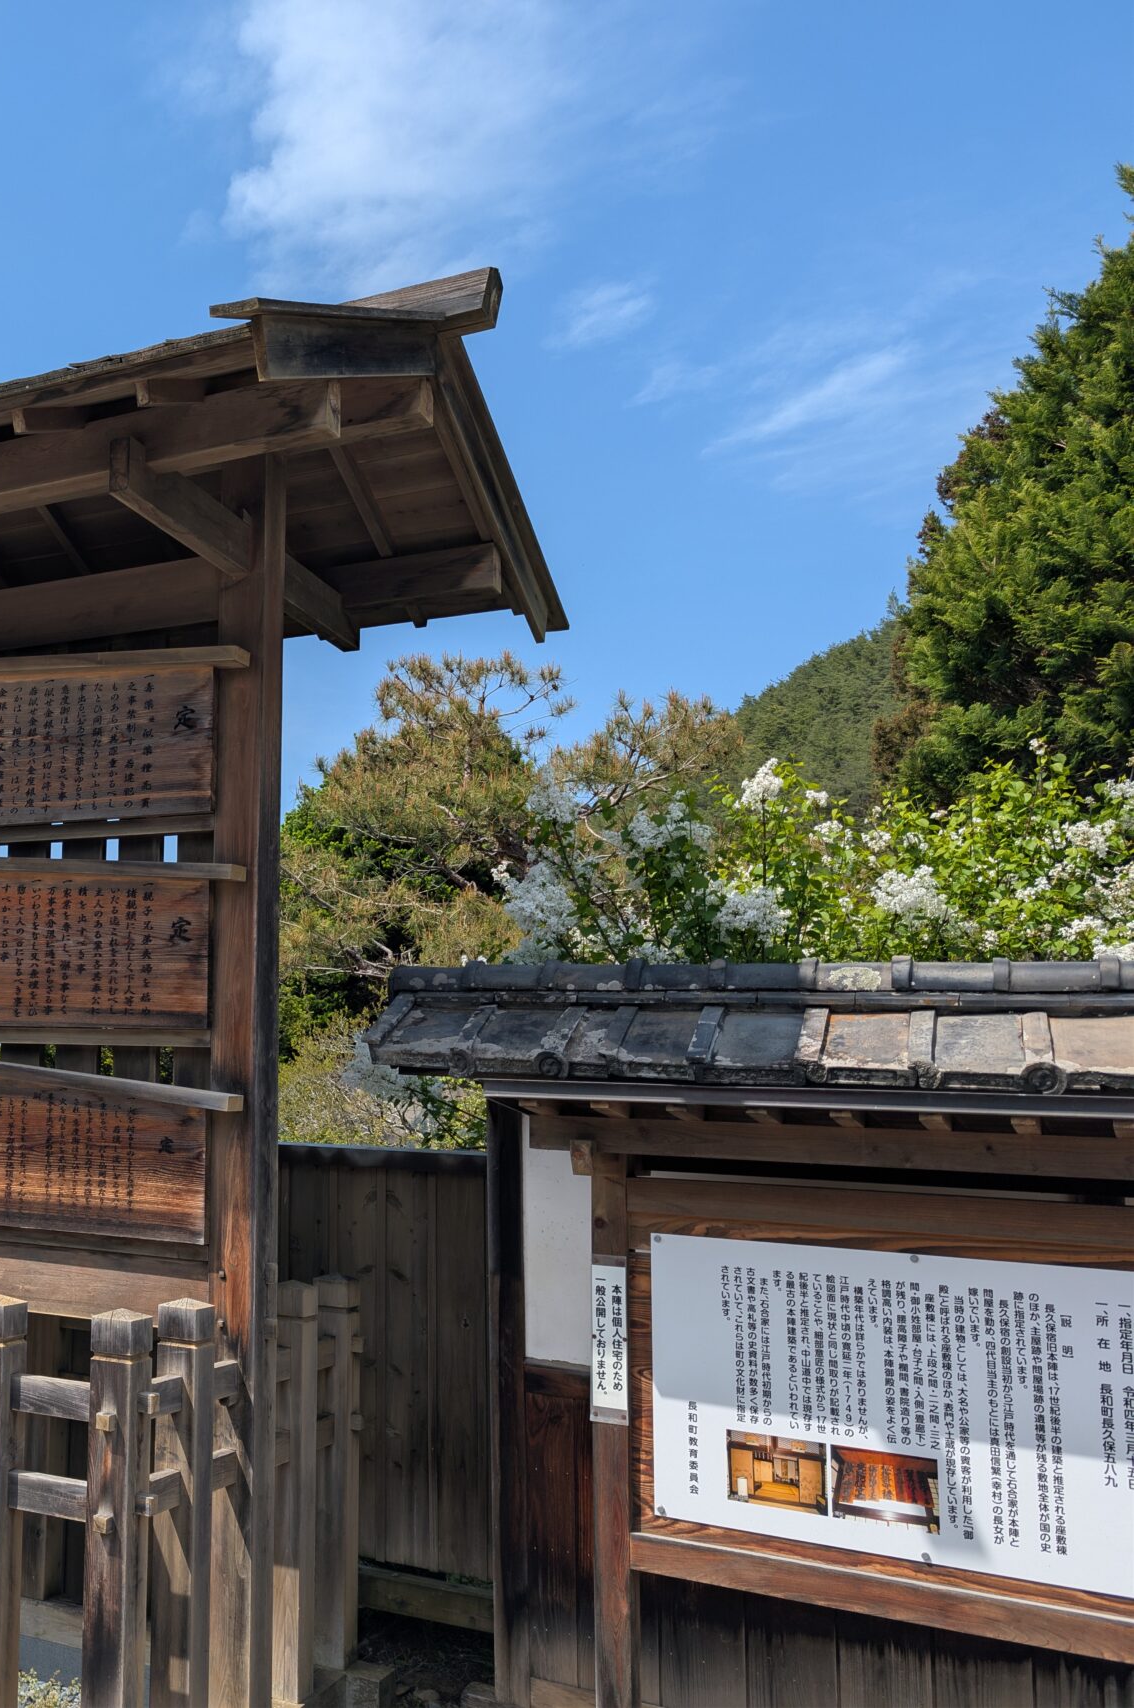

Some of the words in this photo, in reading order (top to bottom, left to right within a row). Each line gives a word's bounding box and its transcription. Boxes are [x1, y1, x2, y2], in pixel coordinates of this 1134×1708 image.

[173, 705, 196, 730] 定
[169, 916, 194, 942] 定
[158, 1136, 175, 1155] 定
[595, 1277, 607, 1395] 一般公開しておりません。
[611, 1284, 623, 1392] 本陣は個人住宅のため
[720, 1265, 731, 1321] されています。
[733, 1266, 746, 1423] されていて、これらは町の文化財に指定
[746, 1267, 759, 1425] 古文書や高札等の史資料が数多く保存
[759, 1277, 773, 1426] また、石合家には江戸時代初期からの
[772, 1269, 782, 1291] ます。
[785, 1271, 799, 1430] る最古の本陣建築であるといわれてい
[798, 1272, 812, 1432] 紀後半と推定され、中山道中では現存す
[826, 1274, 841, 1436] 絵図面に現状と同じ間取りが記載され
[867, 1278, 879, 1329] えています。
[968, 1287, 980, 1348] 嫁いでいます。
[1013, 1291, 1028, 1390] 跡に指定されています。
[1117, 1304, 1133, 1375] 一、指定年月日
[853, 1286, 869, 1440] 構築年代は詳らかではありませんが、
[881, 1279, 897, 1444] 格調高い内装は、本陣御殿の姿をよく伝
[895, 1280, 911, 1445] が残り、腰高障子や欄間、書院造り等の
[924, 1293, 940, 1450] 座敷棟には、上段之間・二之間・三之
[938, 1284, 959, 1529] 殿」と呼ばれる座敷棟のほか、表門や土蔵が現存しています。
[954, 1295, 974, 1540] 当時の建物としては、大名や公家等の賓客が利用した「御
[998, 1299, 1020, 1548] 長久保宿の創設当初から江戸時代を通じて石合家が本陣と
[1028, 1293, 1051, 1553] のほか、主屋跡や問屋場跡の遺構等が残る敷地全体が国の史
[1044, 1303, 1068, 1556] 長久保宿旧本陣は、17世紀後半の建築と推定される座敷棟
[1100, 1383, 1118, 1488] 長和町長久保五八九
[688, 1400, 699, 1495] 長和町教育委員会
